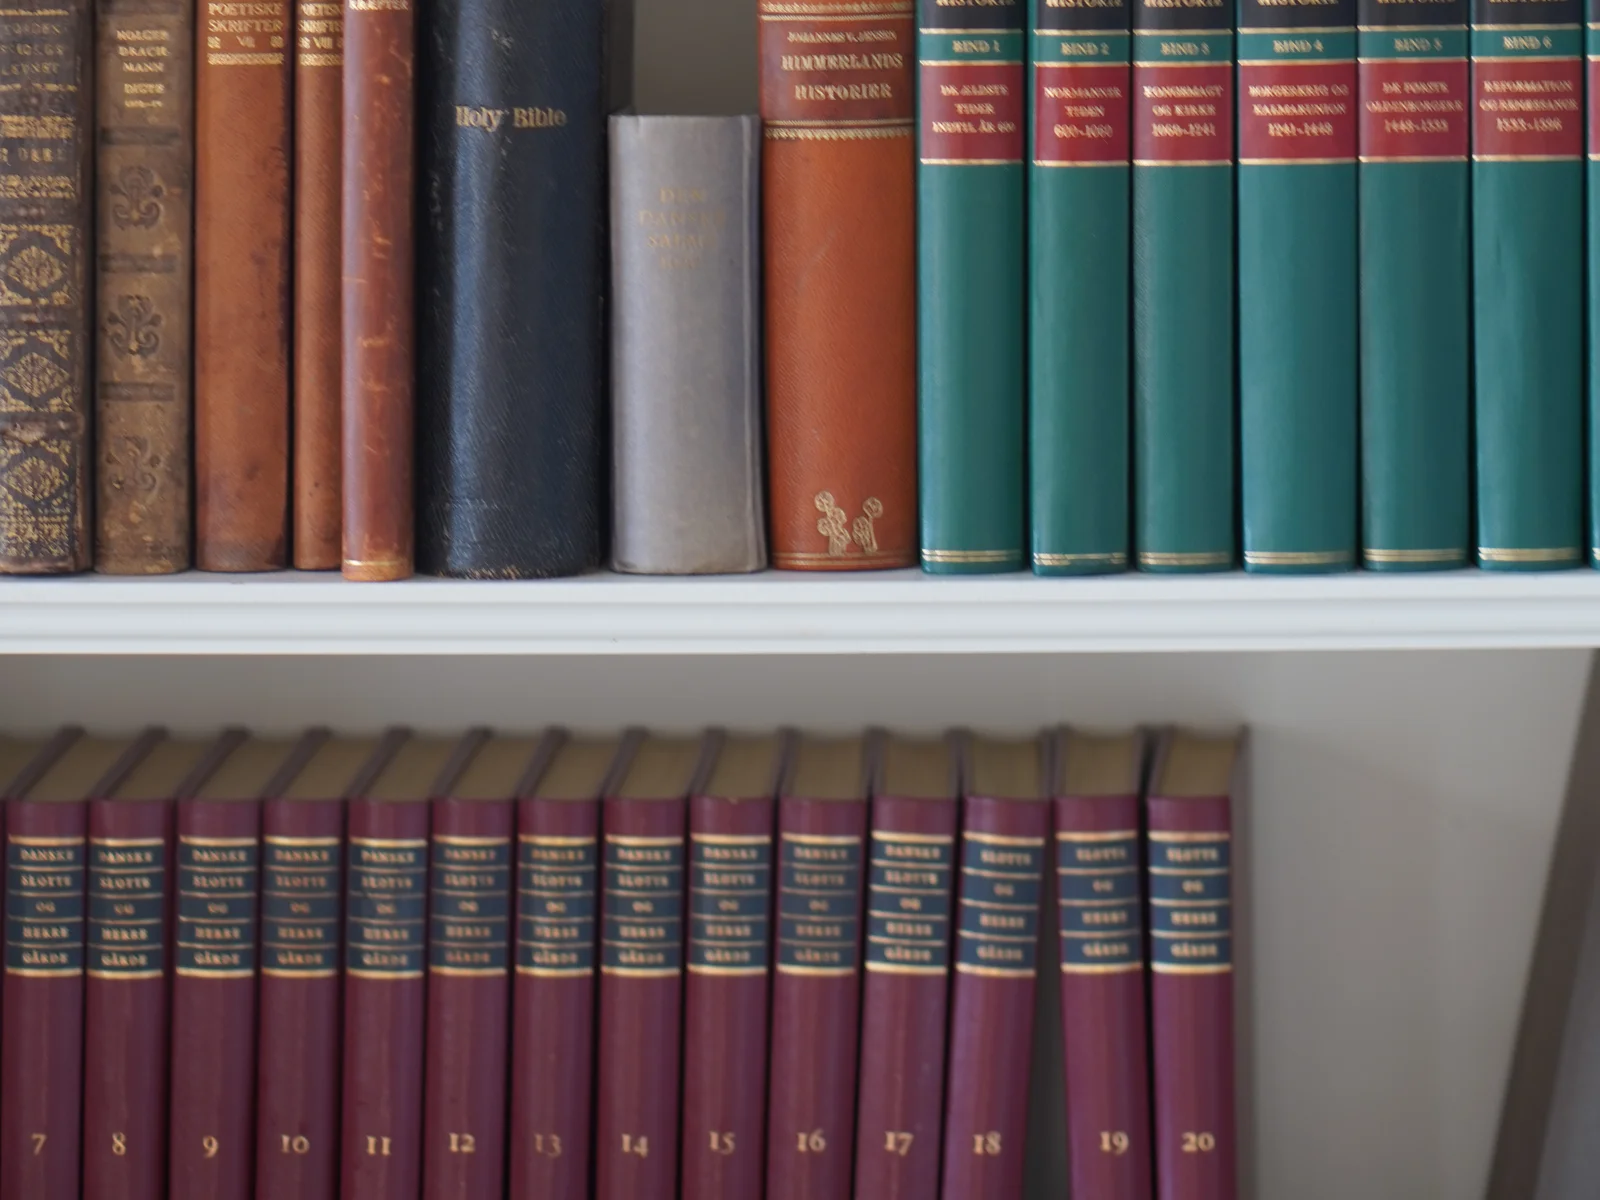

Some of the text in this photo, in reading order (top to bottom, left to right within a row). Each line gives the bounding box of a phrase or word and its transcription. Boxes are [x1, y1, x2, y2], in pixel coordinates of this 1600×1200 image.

[208, 2, 283, 16] POETISKE
[207, 18, 284, 33] SKRIFTER
[952, 40, 990, 53] BIND
[1060, 42, 1099, 55] BIND
[1160, 42, 1199, 55] BIND
[1272, 40, 1312, 53] BIND
[1503, 36, 1541, 50] BIND
[781, 53, 903, 71] HIMMERLANDS
[794, 83, 893, 100] HISTORIER
[456, 105, 567, 133] Holy Bible
[32, 1133, 47, 1155] 7
[112, 1132, 126, 1156] 8
[202, 1135, 219, 1158] 9
[281, 1134, 310, 1154] 10
[366, 1135, 392, 1156] 11
[449, 1132, 476, 1153] 12
[534, 1133, 562, 1158] 13
[621, 1133, 648, 1159] 14
[709, 1131, 735, 1155] 15
[796, 1129, 826, 1153] 16
[884, 1131, 914, 1155] 17
[973, 1131, 1002, 1155] 18
[1099, 1131, 1129, 1155] 19
[1181, 1131, 1215, 1152] 20
